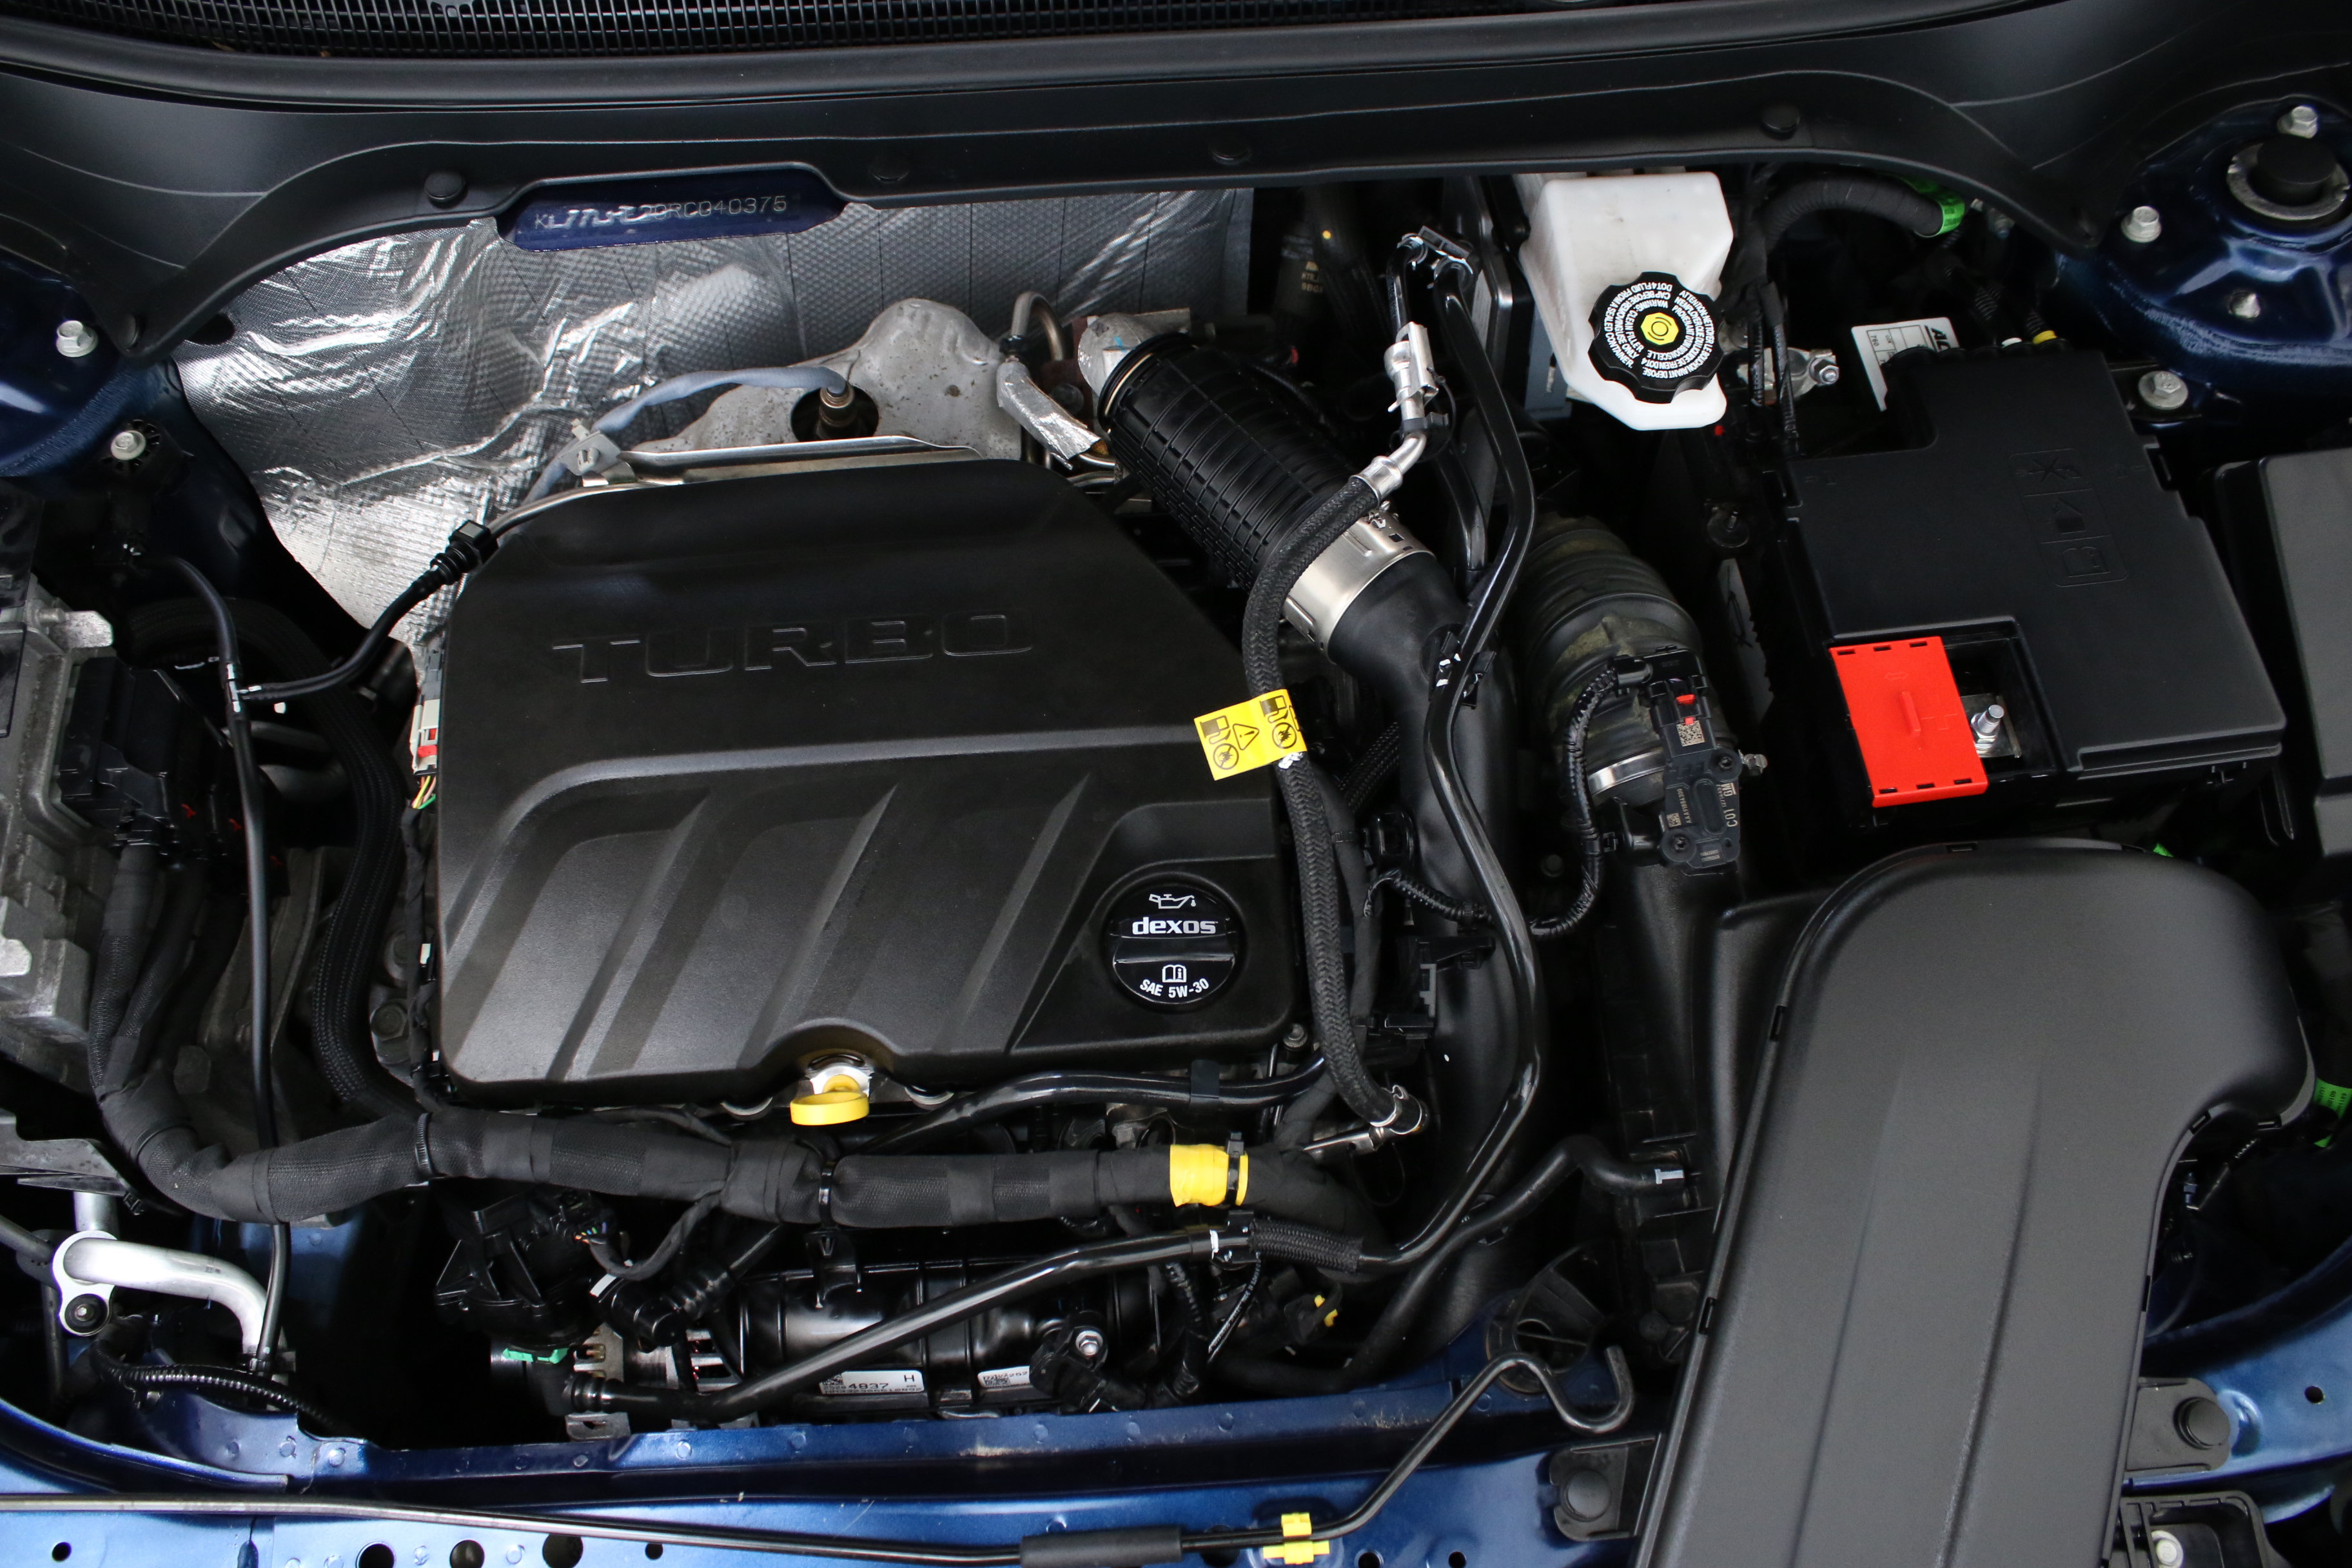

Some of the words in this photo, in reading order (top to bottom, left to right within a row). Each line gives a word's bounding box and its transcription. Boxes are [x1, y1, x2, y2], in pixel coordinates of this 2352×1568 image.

[1631, 282, 1652, 293] FLUID
[1657, 282, 1672, 292] DOT
[1612, 288, 1632, 305] FROM
[1627, 290, 1656, 305] BEFORE
[1654, 291, 1671, 300] CAP
[1604, 307, 1616, 332] SEALED
[1625, 310, 1638, 331] CLEAN
[1672, 305, 1695, 336] PROVENANT
[1695, 325, 1705, 338] QUE
[1701, 315, 1715, 344] NETTOYER
[1615, 331, 1627, 345] USE
[1625, 331, 1644, 353] FILLER
[1694, 337, 1705, 347] DU
[1605, 332, 1634, 369] CONTAINER.
[1622, 343, 1640, 359] ONLY
[1703, 343, 1713, 353] LE
[1641, 357, 1648, 366] 4
[1645, 359, 1659, 369] DOT
[1675, 357, 1687, 367] DE
[1685, 349, 1710, 373] BOUCHON
[1668, 366, 1689, 378] AVANT
[551, 607, 1034, 683] TURBO
[1722, 782, 1734, 797] GM
[1725, 807, 1738, 828] C01
[1132, 916, 1217, 935] dexos
[1139, 979, 1162, 997] SAE
[1168, 977, 1210, 999] 5W-30
[903, 1374, 916, 1383] H
